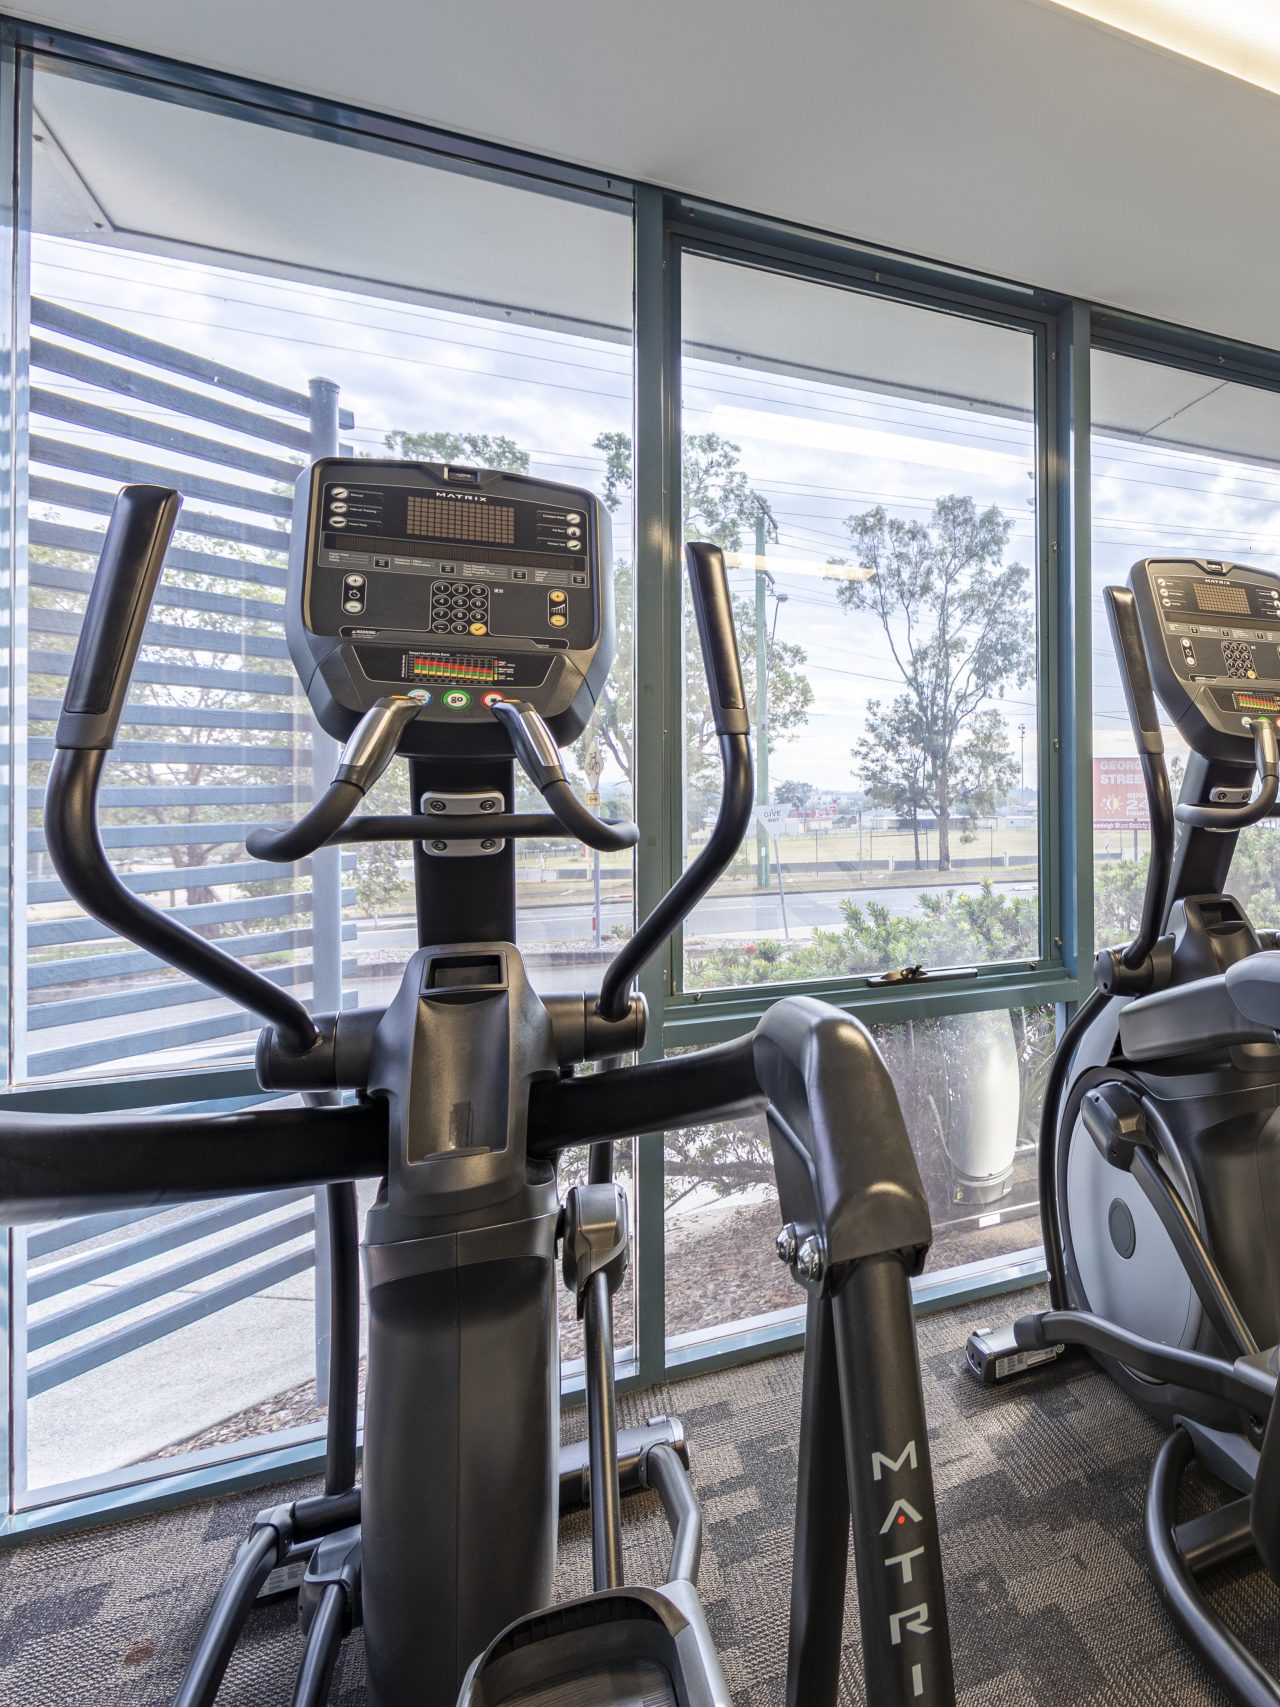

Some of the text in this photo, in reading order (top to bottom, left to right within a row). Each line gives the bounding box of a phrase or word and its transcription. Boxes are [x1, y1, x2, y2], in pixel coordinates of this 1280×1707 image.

[436, 491, 487, 502] MATRIX
[1100, 760, 1142, 770] GEORG
[1100, 774, 1143, 785] STREE
[763, 810, 782, 818] GIVE
[871, 1440, 933, 1697] MATRI
